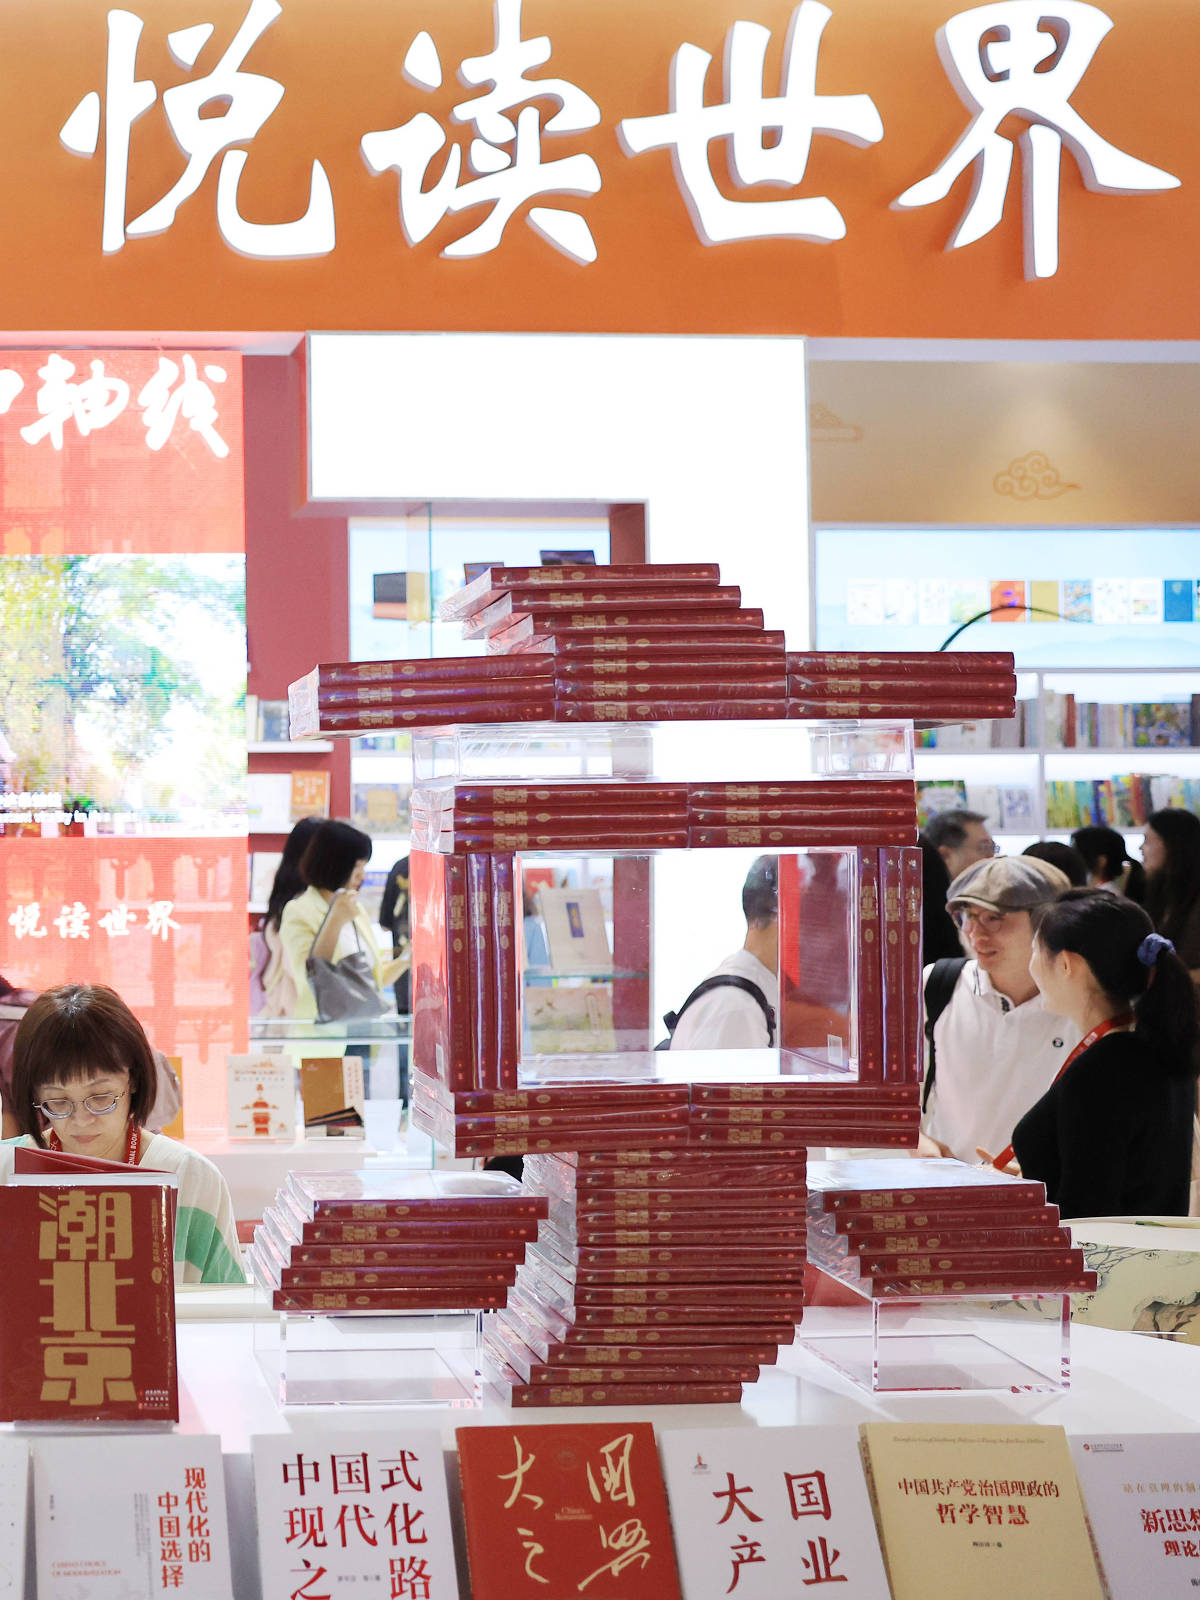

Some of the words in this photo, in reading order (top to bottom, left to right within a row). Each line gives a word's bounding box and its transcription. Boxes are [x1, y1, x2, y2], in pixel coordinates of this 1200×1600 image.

[60, 0, 1181, 281] 悦读世界
[8, 901, 180, 940] 悦读世界
[282, 1450, 423, 1496] 中国式
[898, 1478, 1060, 1498] 中国共产党治国理政的
[184, 1467, 211, 1562] 现代化的
[712, 1470, 832, 1525] 大国
[936, 1503, 1030, 1525] 哲学智慧
[158, 1491, 184, 1588] 中国选择
[283, 1502, 428, 1549] 现代化
[1163, 1540, 1200, 1558] 理论
[726, 1534, 848, 1594] 产业
